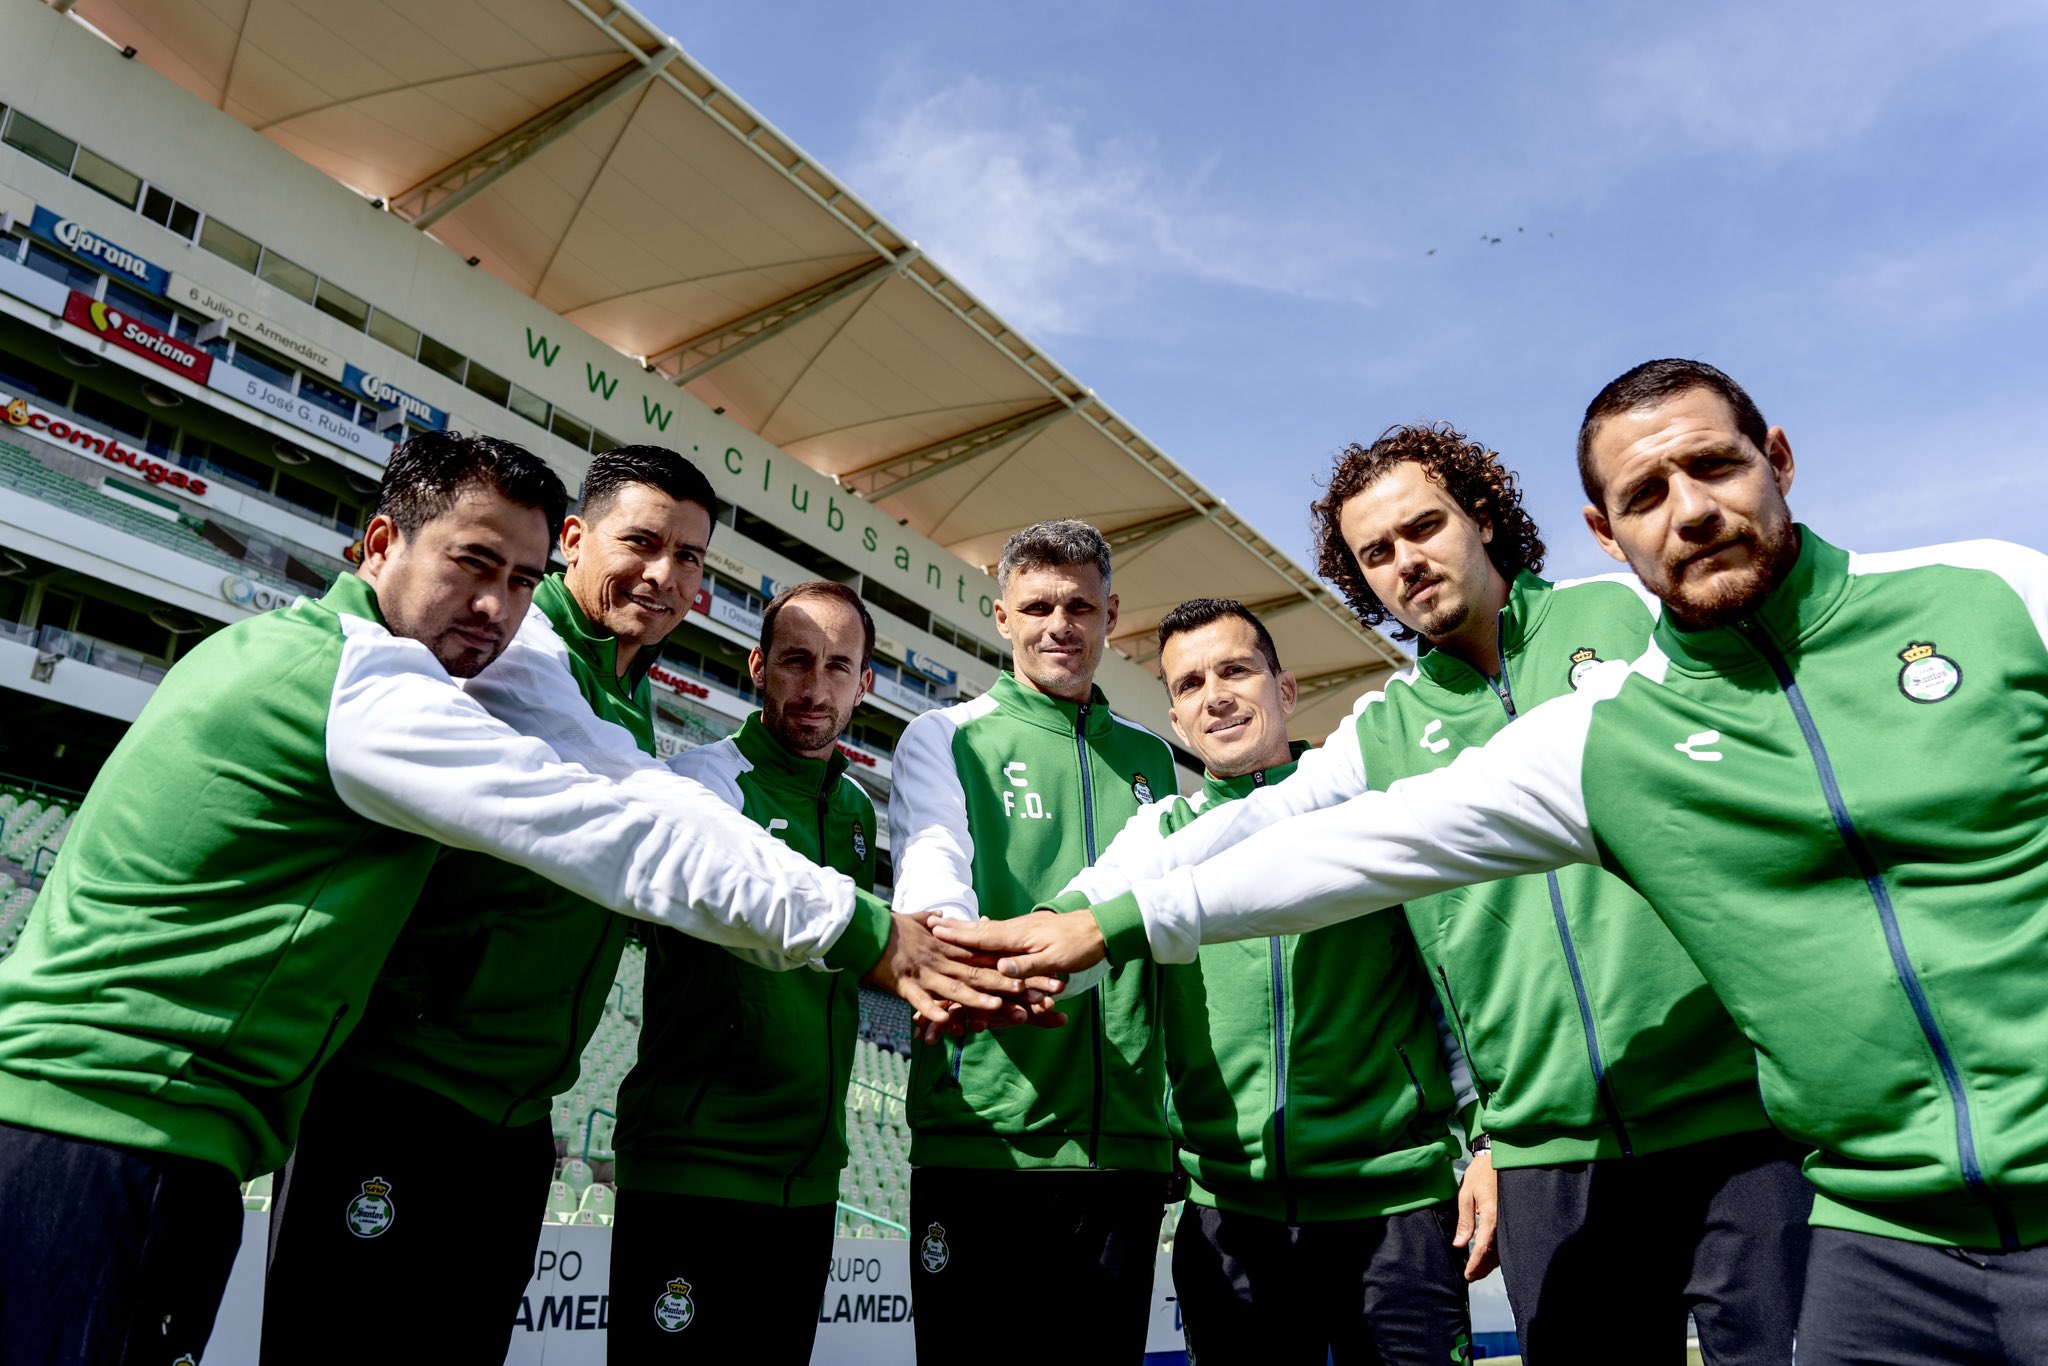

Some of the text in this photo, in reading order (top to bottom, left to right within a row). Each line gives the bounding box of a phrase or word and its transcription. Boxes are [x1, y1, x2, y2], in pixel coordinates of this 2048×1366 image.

[54, 218, 149, 282] Corona
[189, 288, 199, 300] 6
[202, 296, 233, 319] Julio
[123, 323, 196, 368] Soriana
[247, 381, 257, 395] 5
[260, 387, 294, 413] José
[318, 413, 360, 443] Rubio
[361, 372, 433, 423] Corona
[28, 413, 209, 496] combugas
[354, 1207, 384, 1219] Santos
[661, 1304, 686, 1315] Santos
